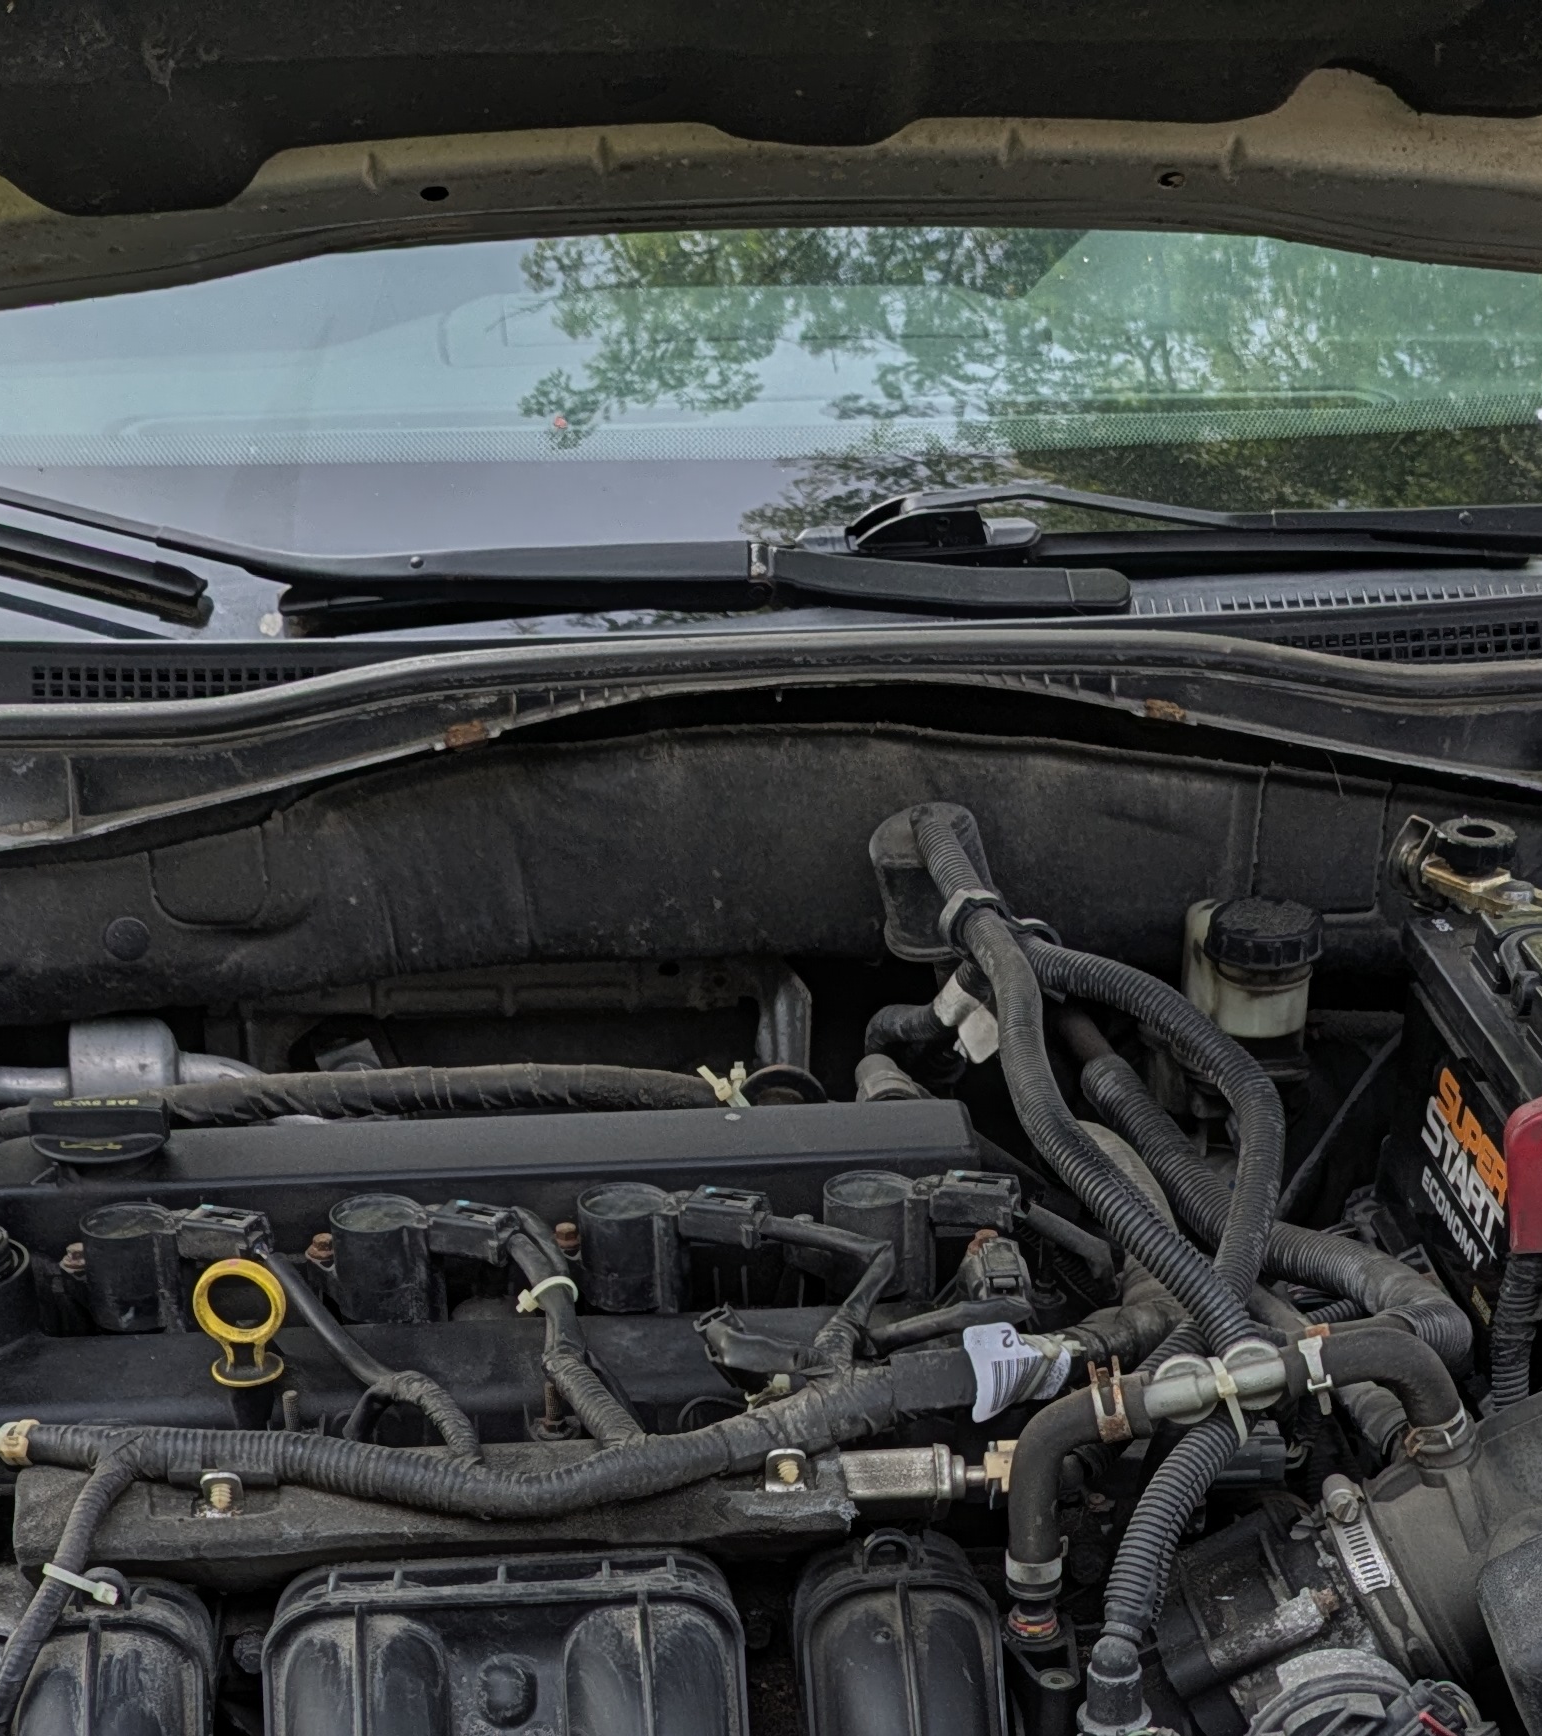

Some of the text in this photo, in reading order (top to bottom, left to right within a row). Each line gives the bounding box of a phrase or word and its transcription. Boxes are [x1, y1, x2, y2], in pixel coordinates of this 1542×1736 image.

[105, 1098, 139, 1107] SAE
[1435, 1066, 1508, 1208] SUPER
[1420, 1094, 1506, 1242] START
[1420, 1164, 1484, 1271] ECONOMY
